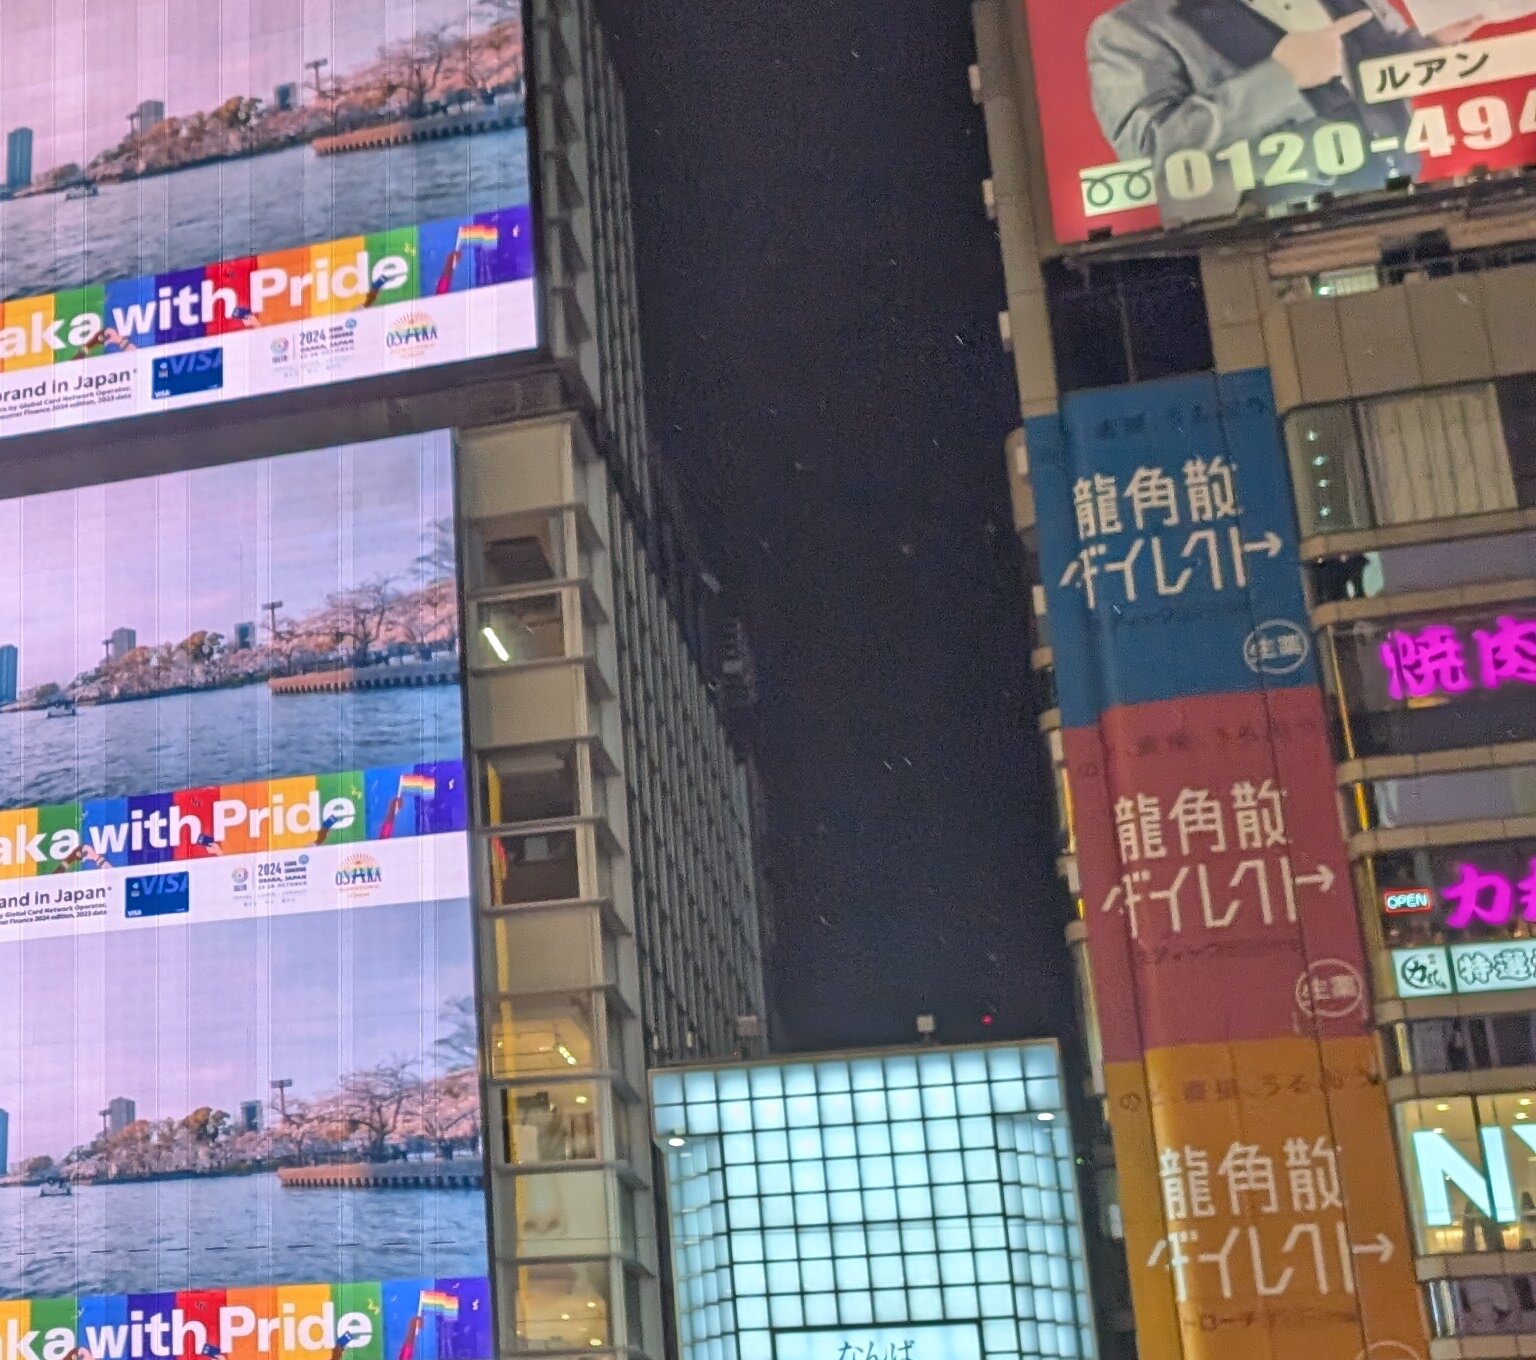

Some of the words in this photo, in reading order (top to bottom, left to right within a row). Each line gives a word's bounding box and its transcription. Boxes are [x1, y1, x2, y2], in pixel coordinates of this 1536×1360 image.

[1374, 49, 1491, 95] ルアン
[112, 277, 238, 337] with
[249, 251, 409, 314] Pride
[299, 332, 326, 346] 2024
[51, 378, 70, 394] in
[1073, 455, 1242, 540] 龍角散
[90, 804, 202, 855] with
[213, 791, 356, 841] Pride
[1114, 778, 1292, 865] 龍角散
[257, 862, 282, 877] 2024
[335, 866, 382, 887] OSAKA
[34, 890, 51, 905] in
[1386, 892, 1430, 910] OPEN
[1159, 1136, 1348, 1219] 龍角散
[84, 1308, 207, 1359] with
[218, 1302, 373, 1354] Pride
